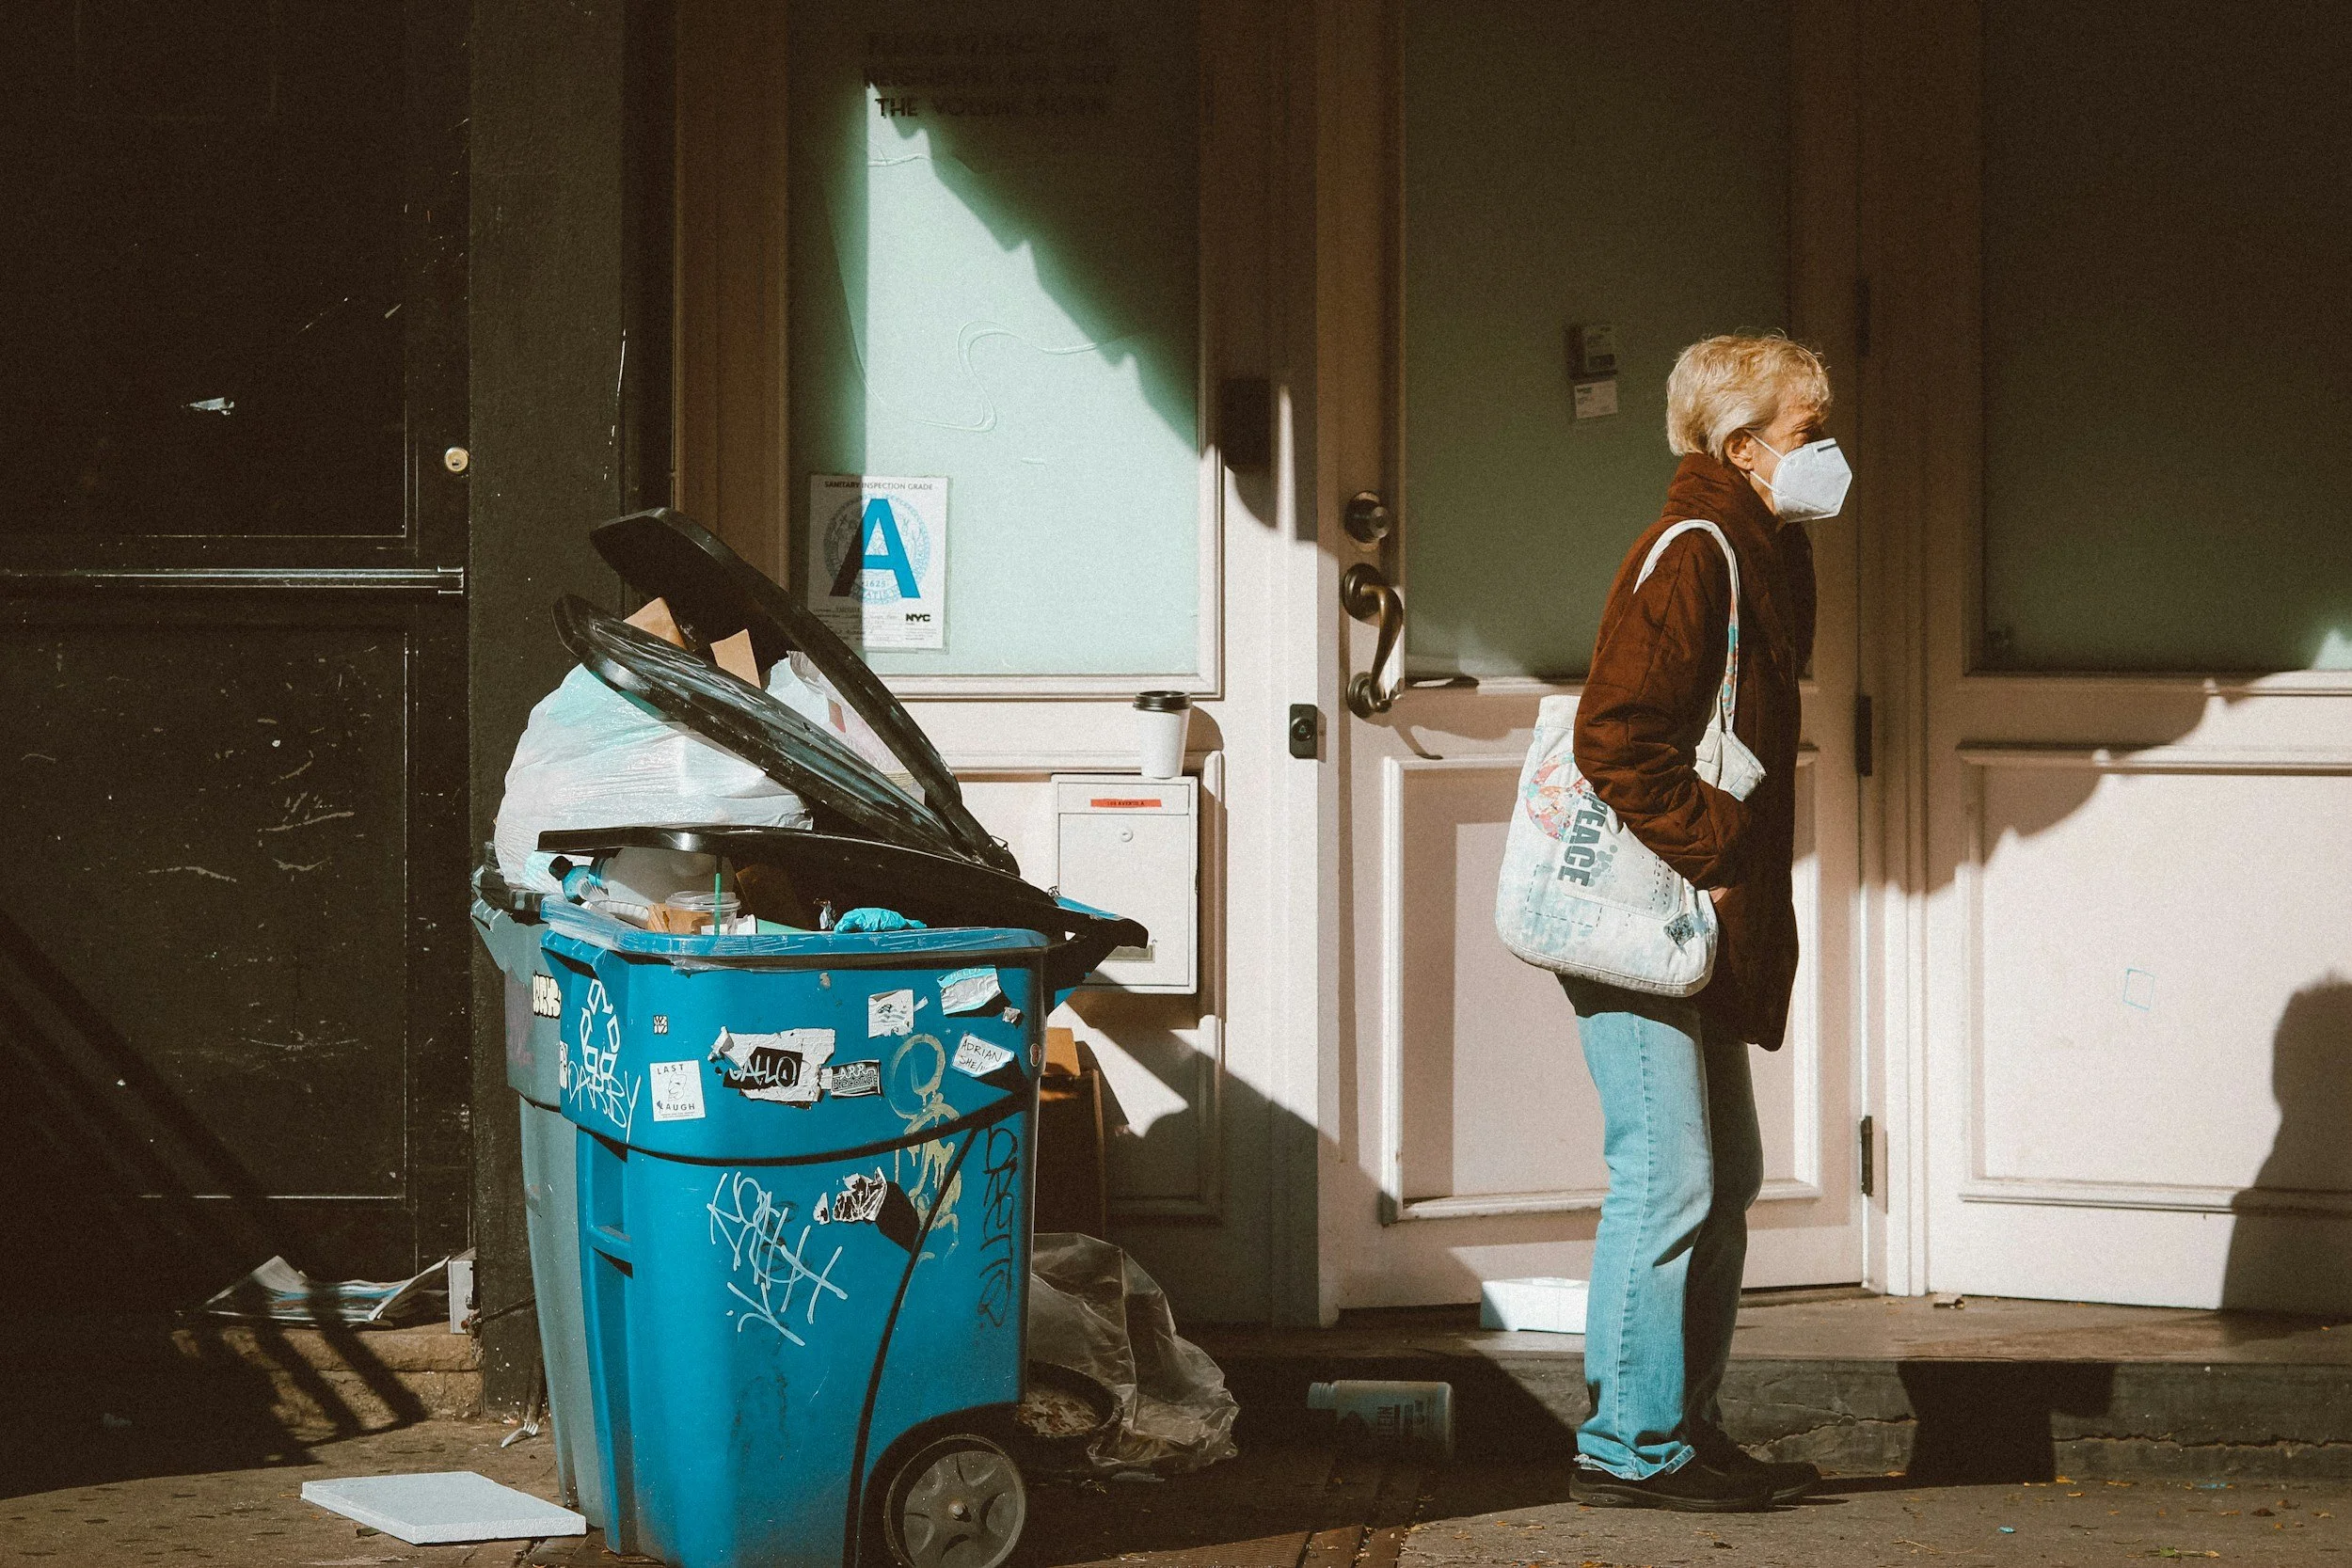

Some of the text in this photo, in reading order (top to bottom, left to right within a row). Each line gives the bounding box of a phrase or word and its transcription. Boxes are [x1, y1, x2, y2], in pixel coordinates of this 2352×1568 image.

[876, 97, 918, 117] THE
[862, 482, 905, 490] INSPECTION
[829, 499, 921, 598] A
[906, 613, 930, 622] NYC
[1557, 791, 1608, 887] PEACE
[961, 1038, 1003, 1063] ADRIAN
[657, 1064, 684, 1075] LAST
